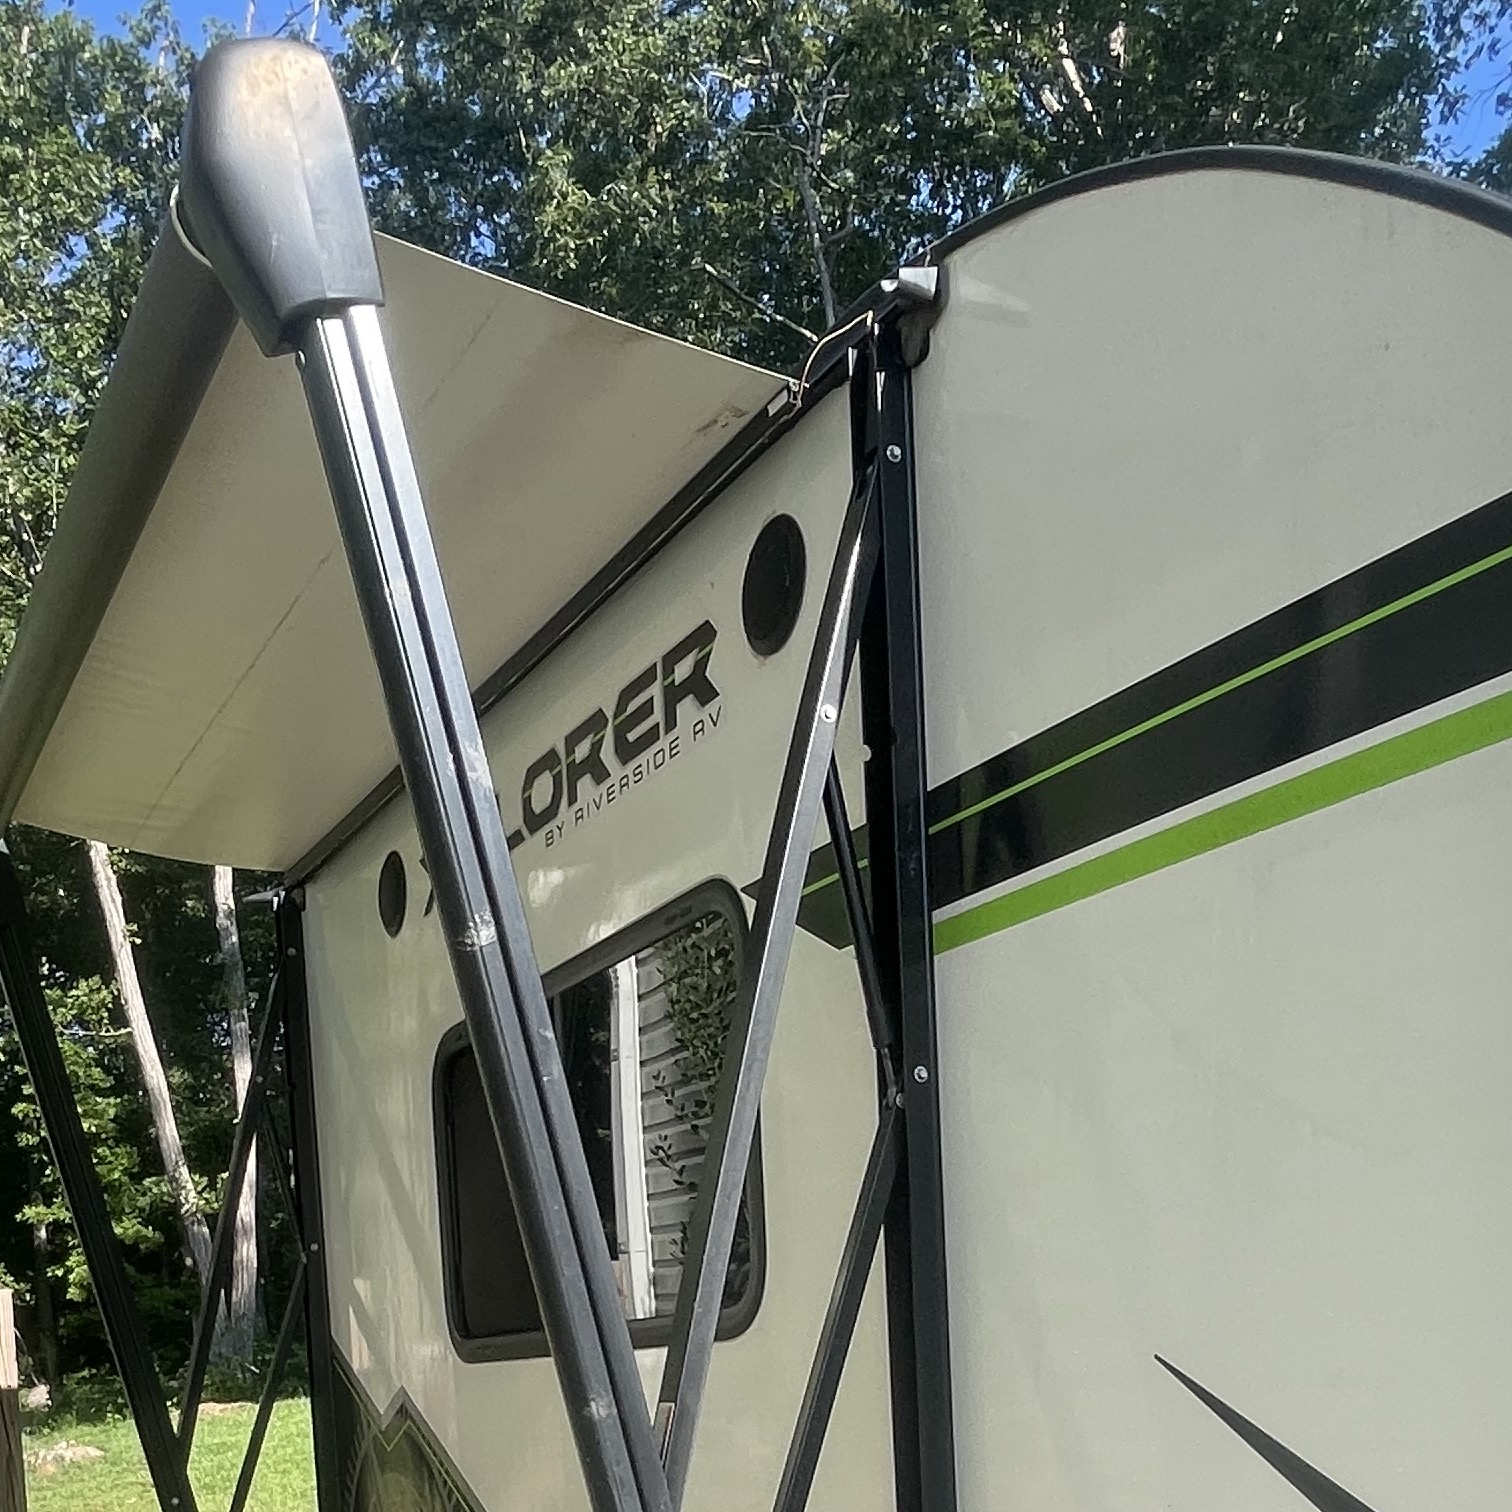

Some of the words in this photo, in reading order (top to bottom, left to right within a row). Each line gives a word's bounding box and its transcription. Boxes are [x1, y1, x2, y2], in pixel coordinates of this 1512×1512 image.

[544, 820, 565, 848] BY
[574, 735, 681, 827] RIVERSIDE
[692, 704, 722, 742] RV
